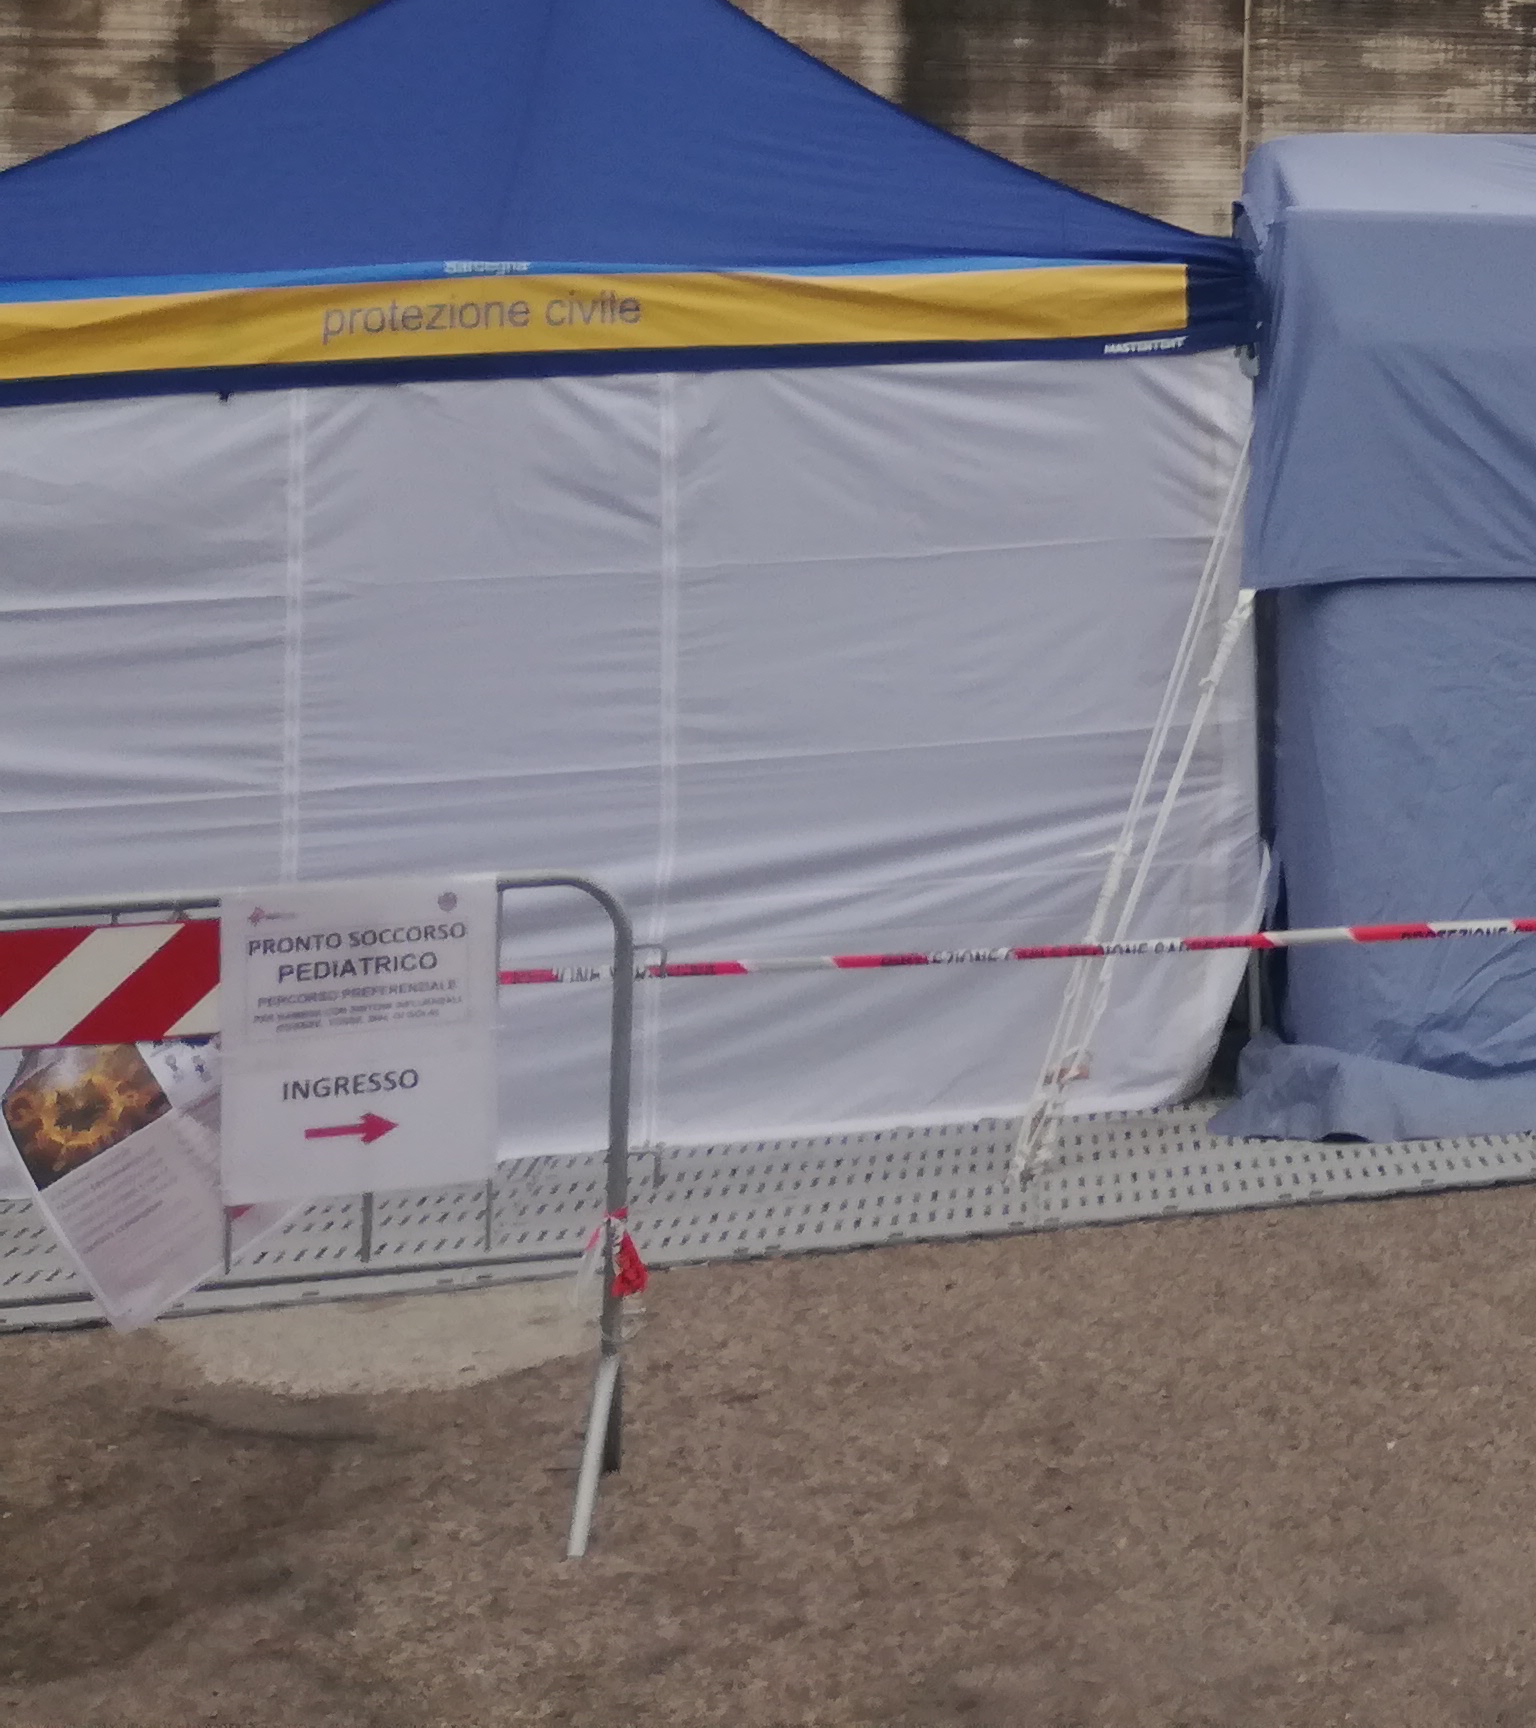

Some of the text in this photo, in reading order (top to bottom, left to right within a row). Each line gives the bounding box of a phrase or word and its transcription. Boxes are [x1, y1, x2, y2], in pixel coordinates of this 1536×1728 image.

[323, 290, 641, 345] protezione civile
[248, 922, 467, 956] PRONTO SOCCORSO
[278, 951, 438, 983] PEDIATRICO
[282, 1069, 419, 1100] INGRESSO
